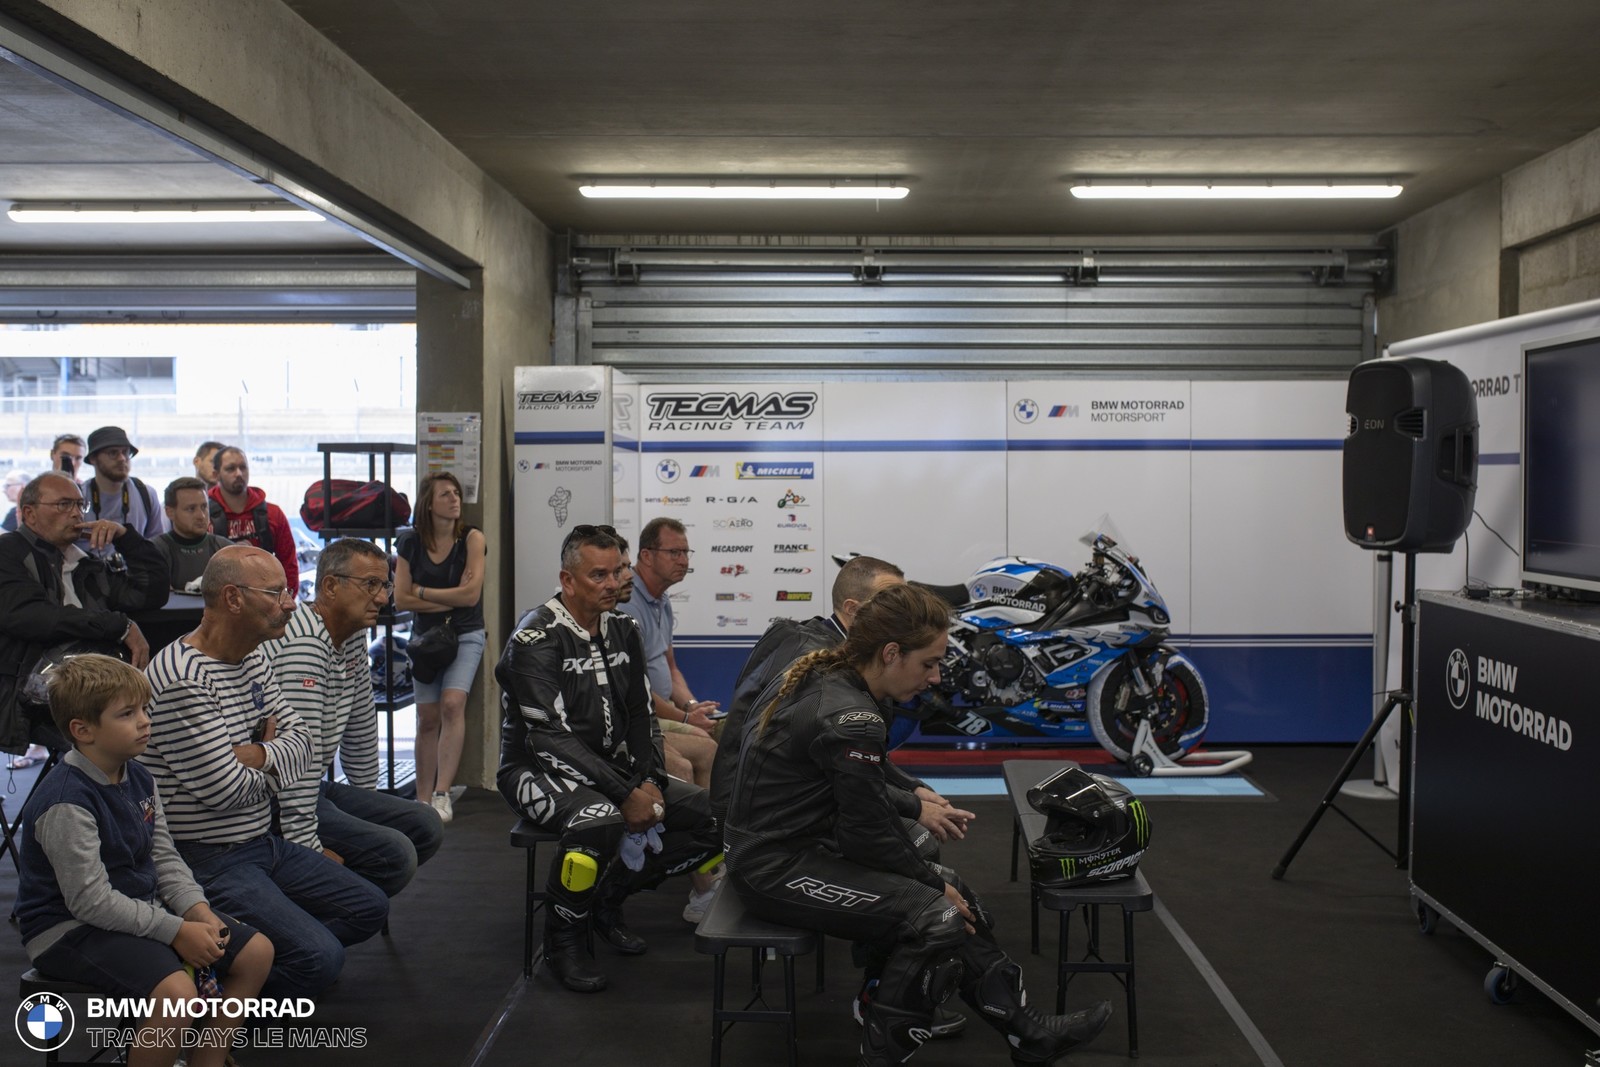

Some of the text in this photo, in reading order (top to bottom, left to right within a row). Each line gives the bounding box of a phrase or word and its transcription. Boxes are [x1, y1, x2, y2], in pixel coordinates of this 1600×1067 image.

[1472, 374, 1521, 398] ORRAD T
[517, 391, 600, 404] TECMAS
[648, 393, 816, 420] TECMAS
[1091, 400, 1184, 410] BMW MOTORRAD
[1091, 412, 1165, 422] MOTORSPORT
[648, 421, 804, 430] RACING TEAM
[1364, 419, 1385, 430] EON
[755, 467, 813, 477] MICHELIN
[711, 545, 754, 553] MECASPORT
[991, 595, 1047, 613] MOTORRAD
[1477, 655, 1518, 693] BMW
[838, 711, 885, 725] RST
[1476, 690, 1573, 751] MOTORRAD
[786, 875, 881, 907] RST
